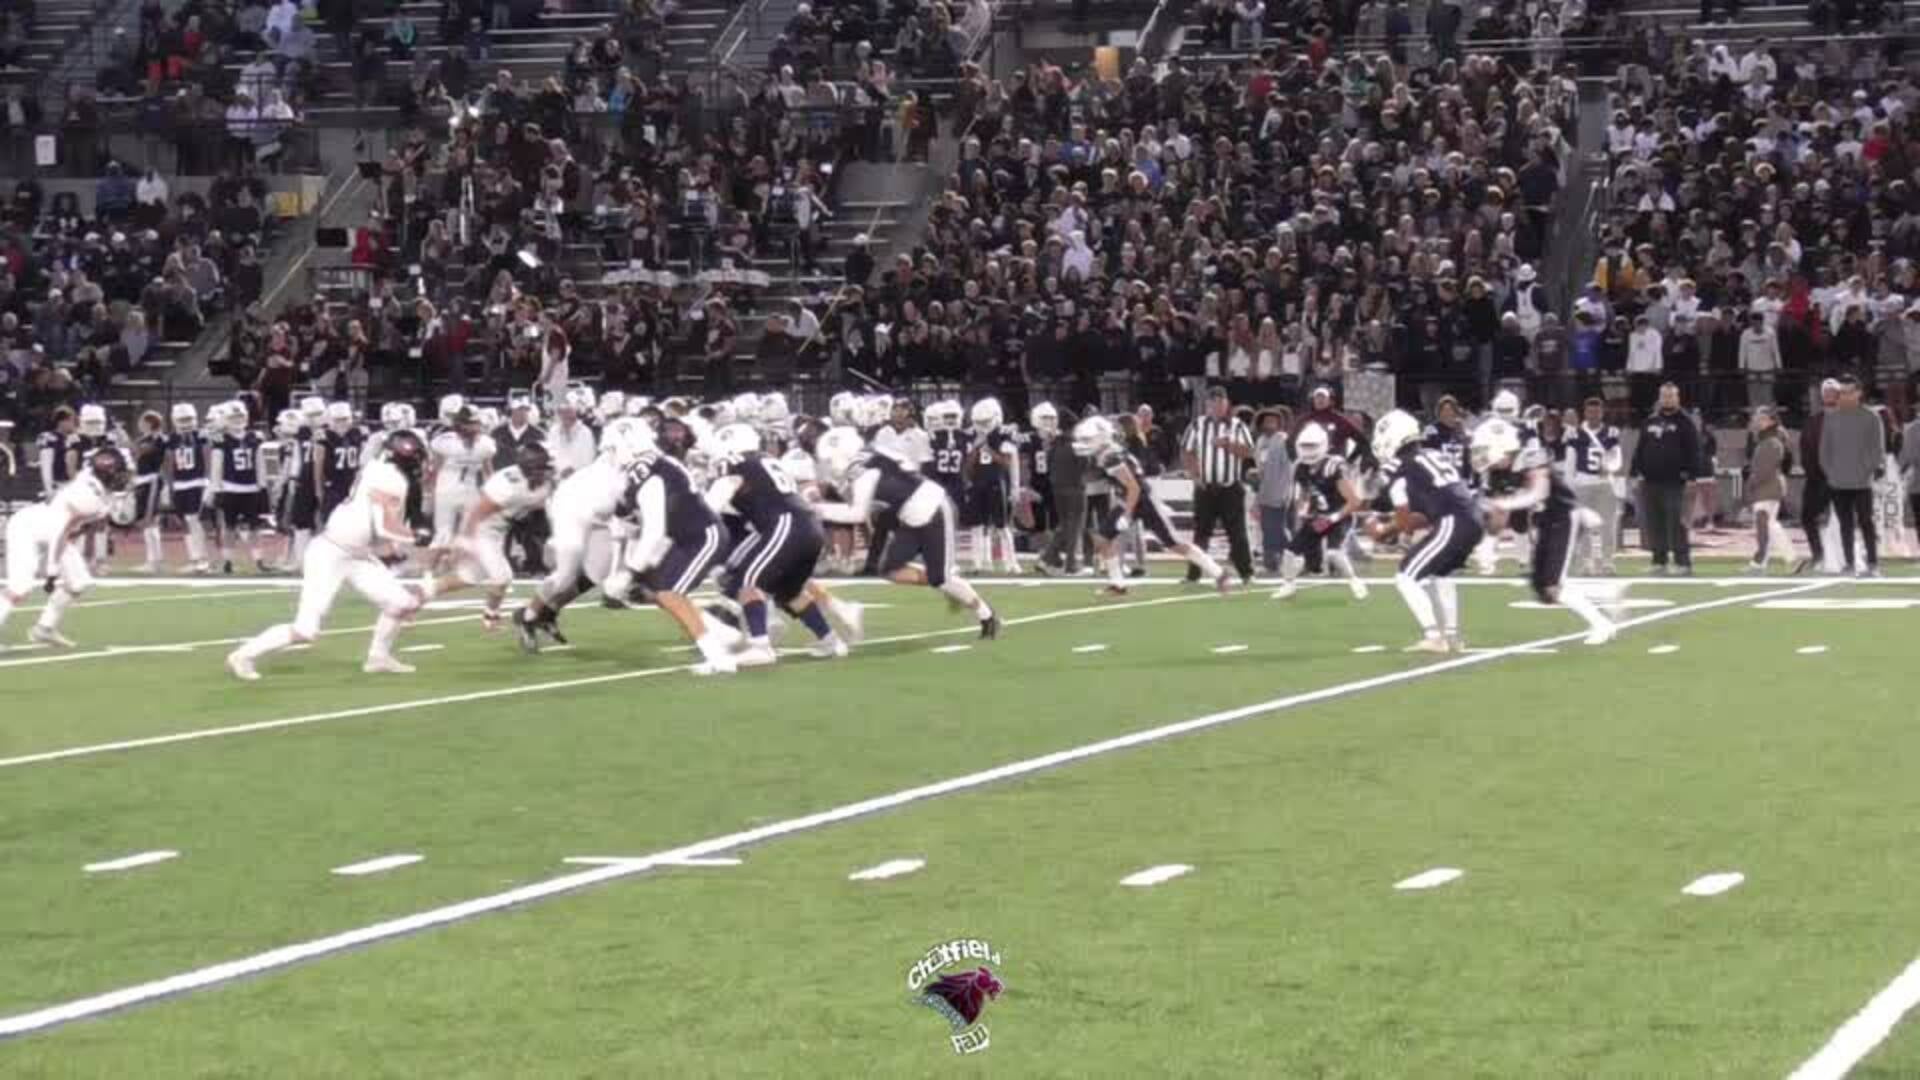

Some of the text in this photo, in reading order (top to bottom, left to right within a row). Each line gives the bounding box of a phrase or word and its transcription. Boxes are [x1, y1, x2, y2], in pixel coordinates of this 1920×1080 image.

[335, 446, 358, 470] 70
[937, 450, 962, 473] 23
[1415, 449, 1460, 487] 15
